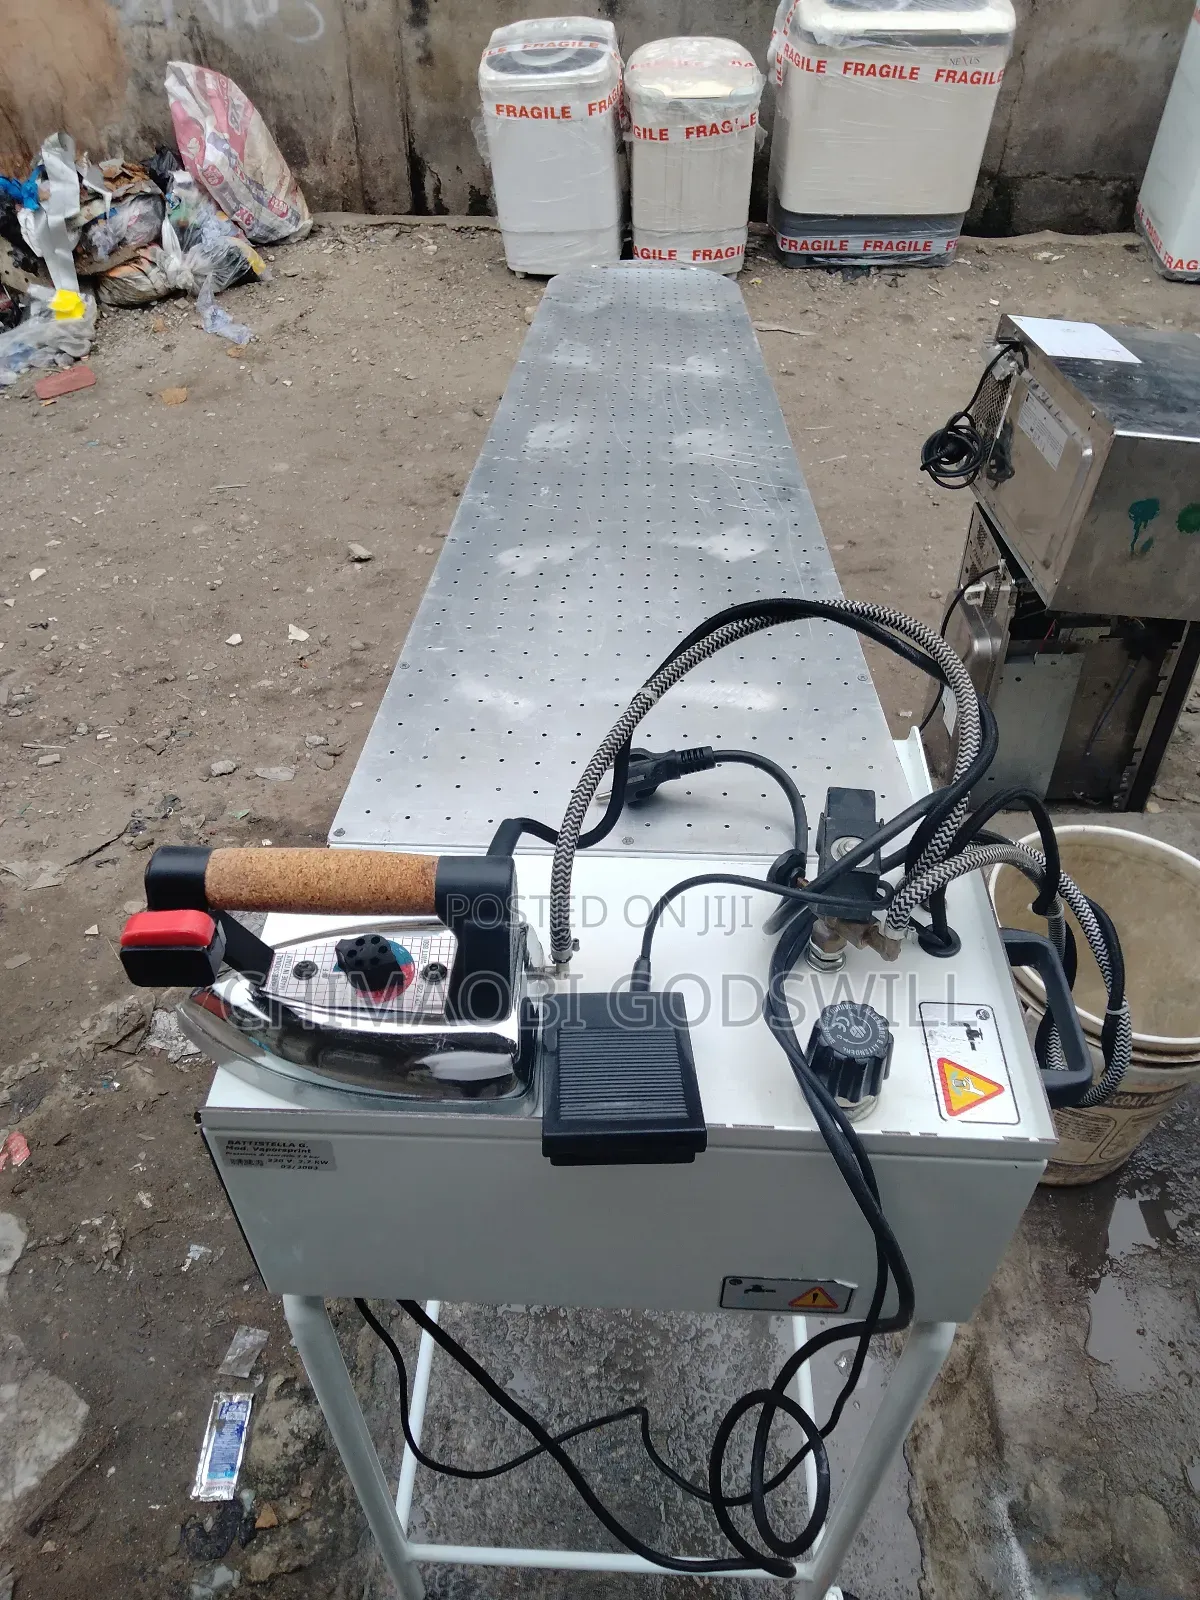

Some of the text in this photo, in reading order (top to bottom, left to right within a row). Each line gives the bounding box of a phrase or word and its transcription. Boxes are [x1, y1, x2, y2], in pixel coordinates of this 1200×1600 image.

[522, 40, 599, 49] FRAGILE
[949, 54, 981, 67] NEXUS
[842, 61, 921, 81] FRAGILE
[495, 103, 572, 120] FRAGILE
[780, 237, 849, 252] FRAGILE
[863, 240, 933, 252] FRAGILE
[227, 1139, 296, 1148] BATTISTELLA
[252, 1146, 312, 1155] Vaporsprint
